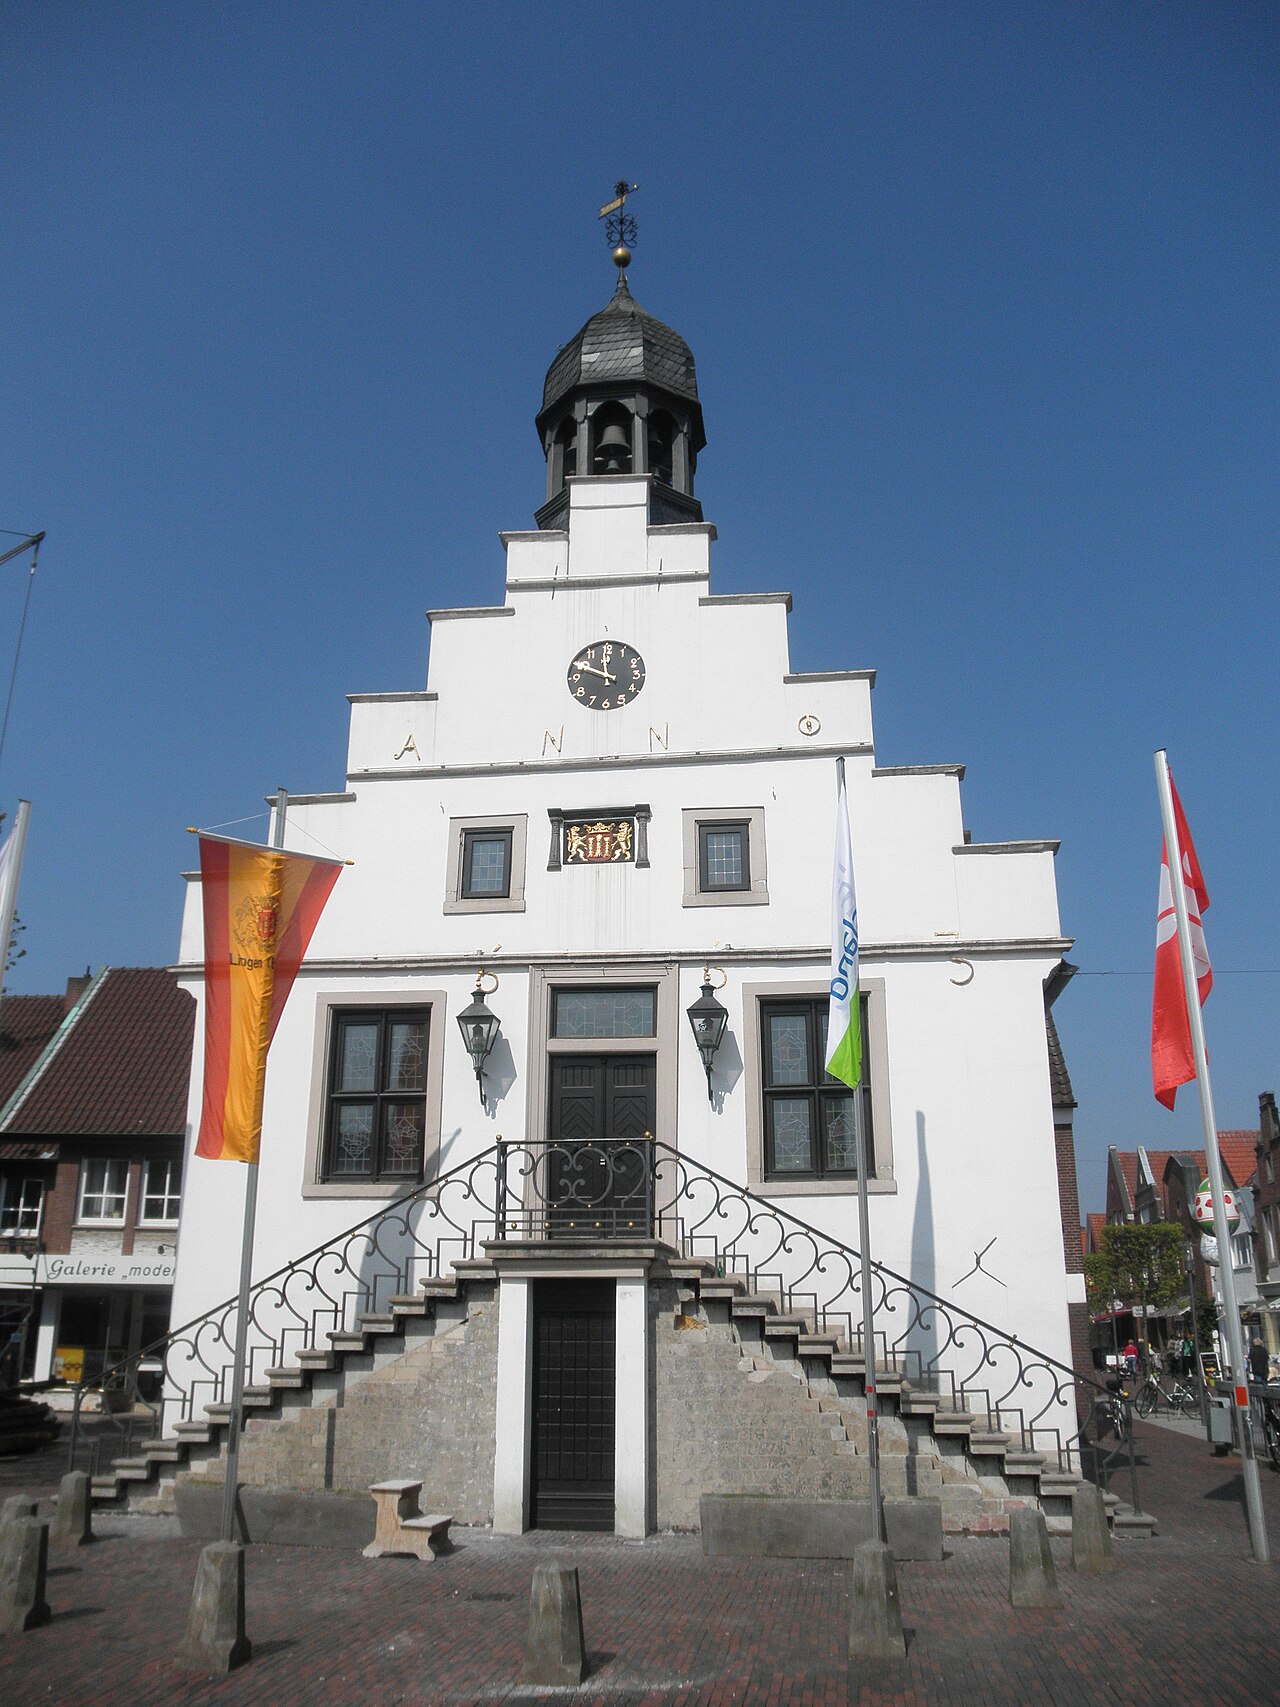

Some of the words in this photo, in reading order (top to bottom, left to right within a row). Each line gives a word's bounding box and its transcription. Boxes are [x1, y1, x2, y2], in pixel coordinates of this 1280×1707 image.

[586, 649, 595, 659] 11
[602, 644, 613, 655] 12
[630, 657, 638, 668] 2
[572, 673, 581, 684] 9
[632, 669, 640, 680] 3
[576, 686, 585, 697] 8
[628, 682, 636, 693] 4
[589, 695, 597, 706] 7
[601, 698, 610, 709] 6
[616, 694, 626, 705] 5
[229, 953, 263, 971] Lingen
[47, 1259, 116, 1280] Galerie
